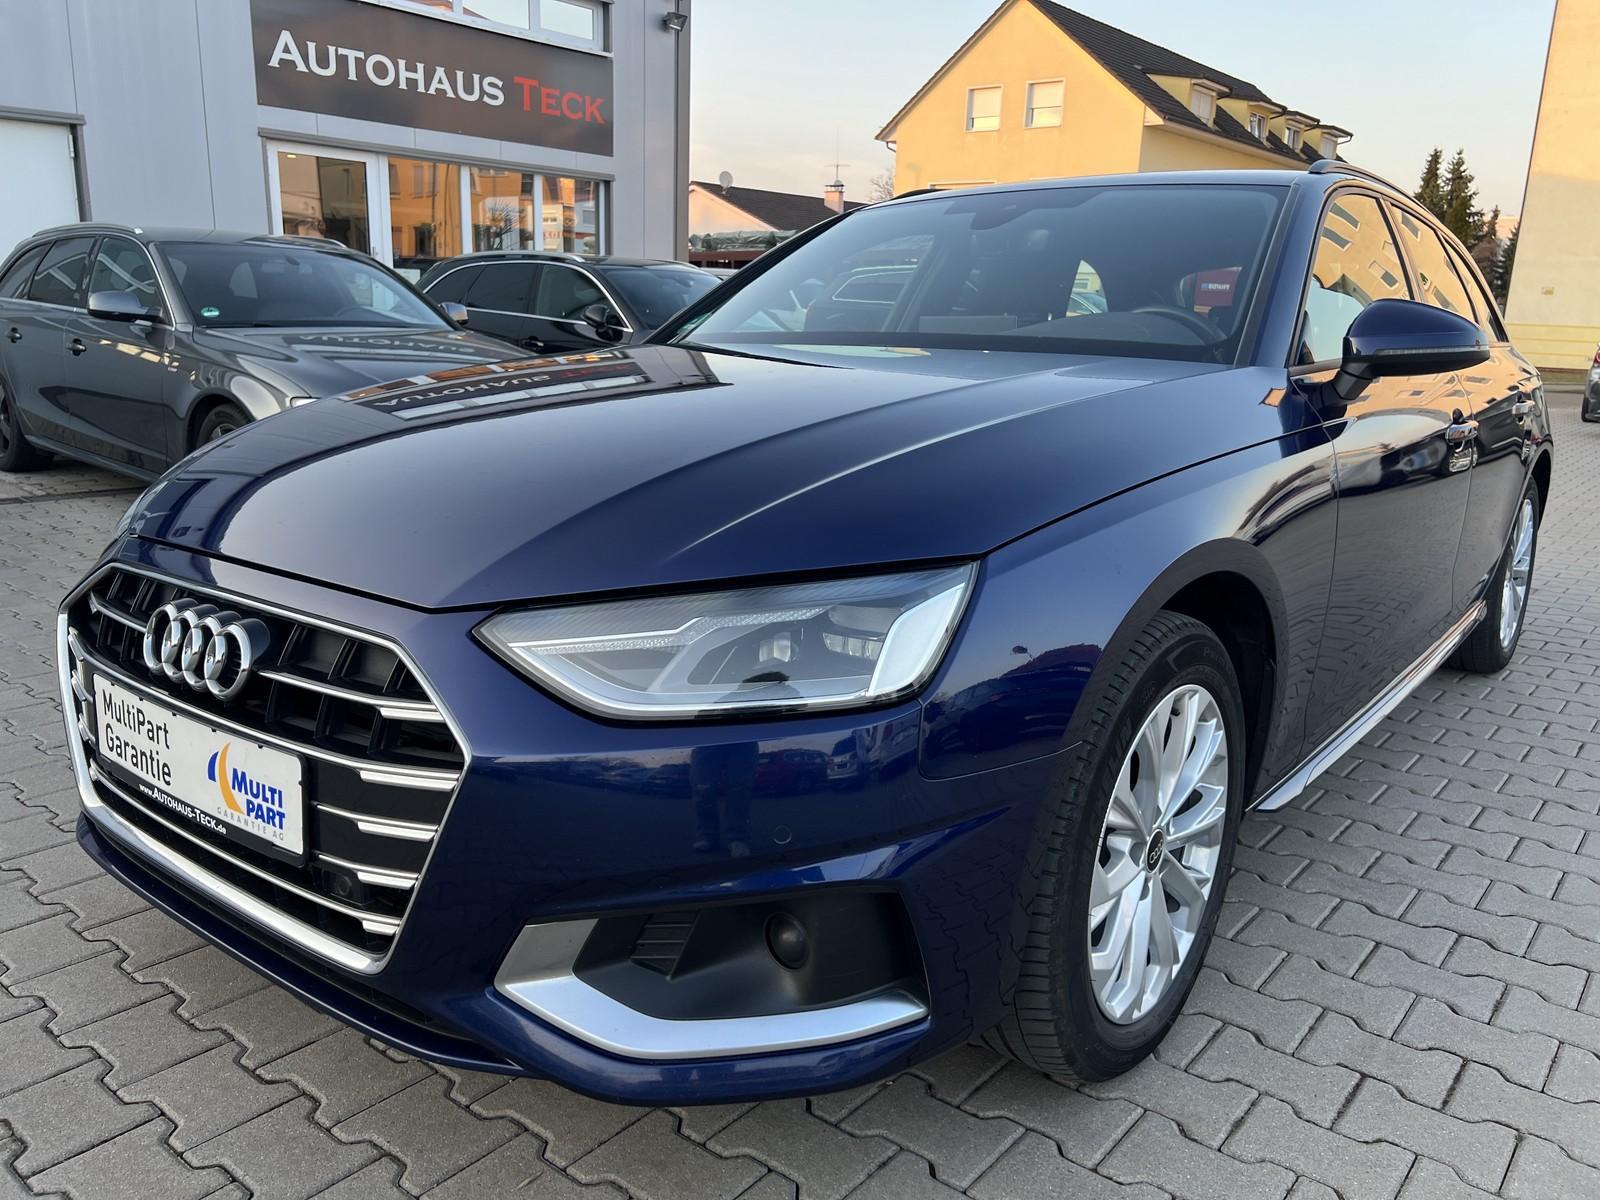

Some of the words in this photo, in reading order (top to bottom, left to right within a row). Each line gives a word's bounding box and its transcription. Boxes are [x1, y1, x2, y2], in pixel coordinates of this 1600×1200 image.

[267, 29, 505, 106] AUTOHAUS
[513, 75, 606, 124] TECK
[102, 689, 170, 750] MultiPart
[105, 722, 172, 786] Garantie
[231, 767, 284, 809] MULTI
[217, 806, 267, 834] GARANTIE
[272, 831, 284, 841] AG
[246, 798, 286, 830] PART
